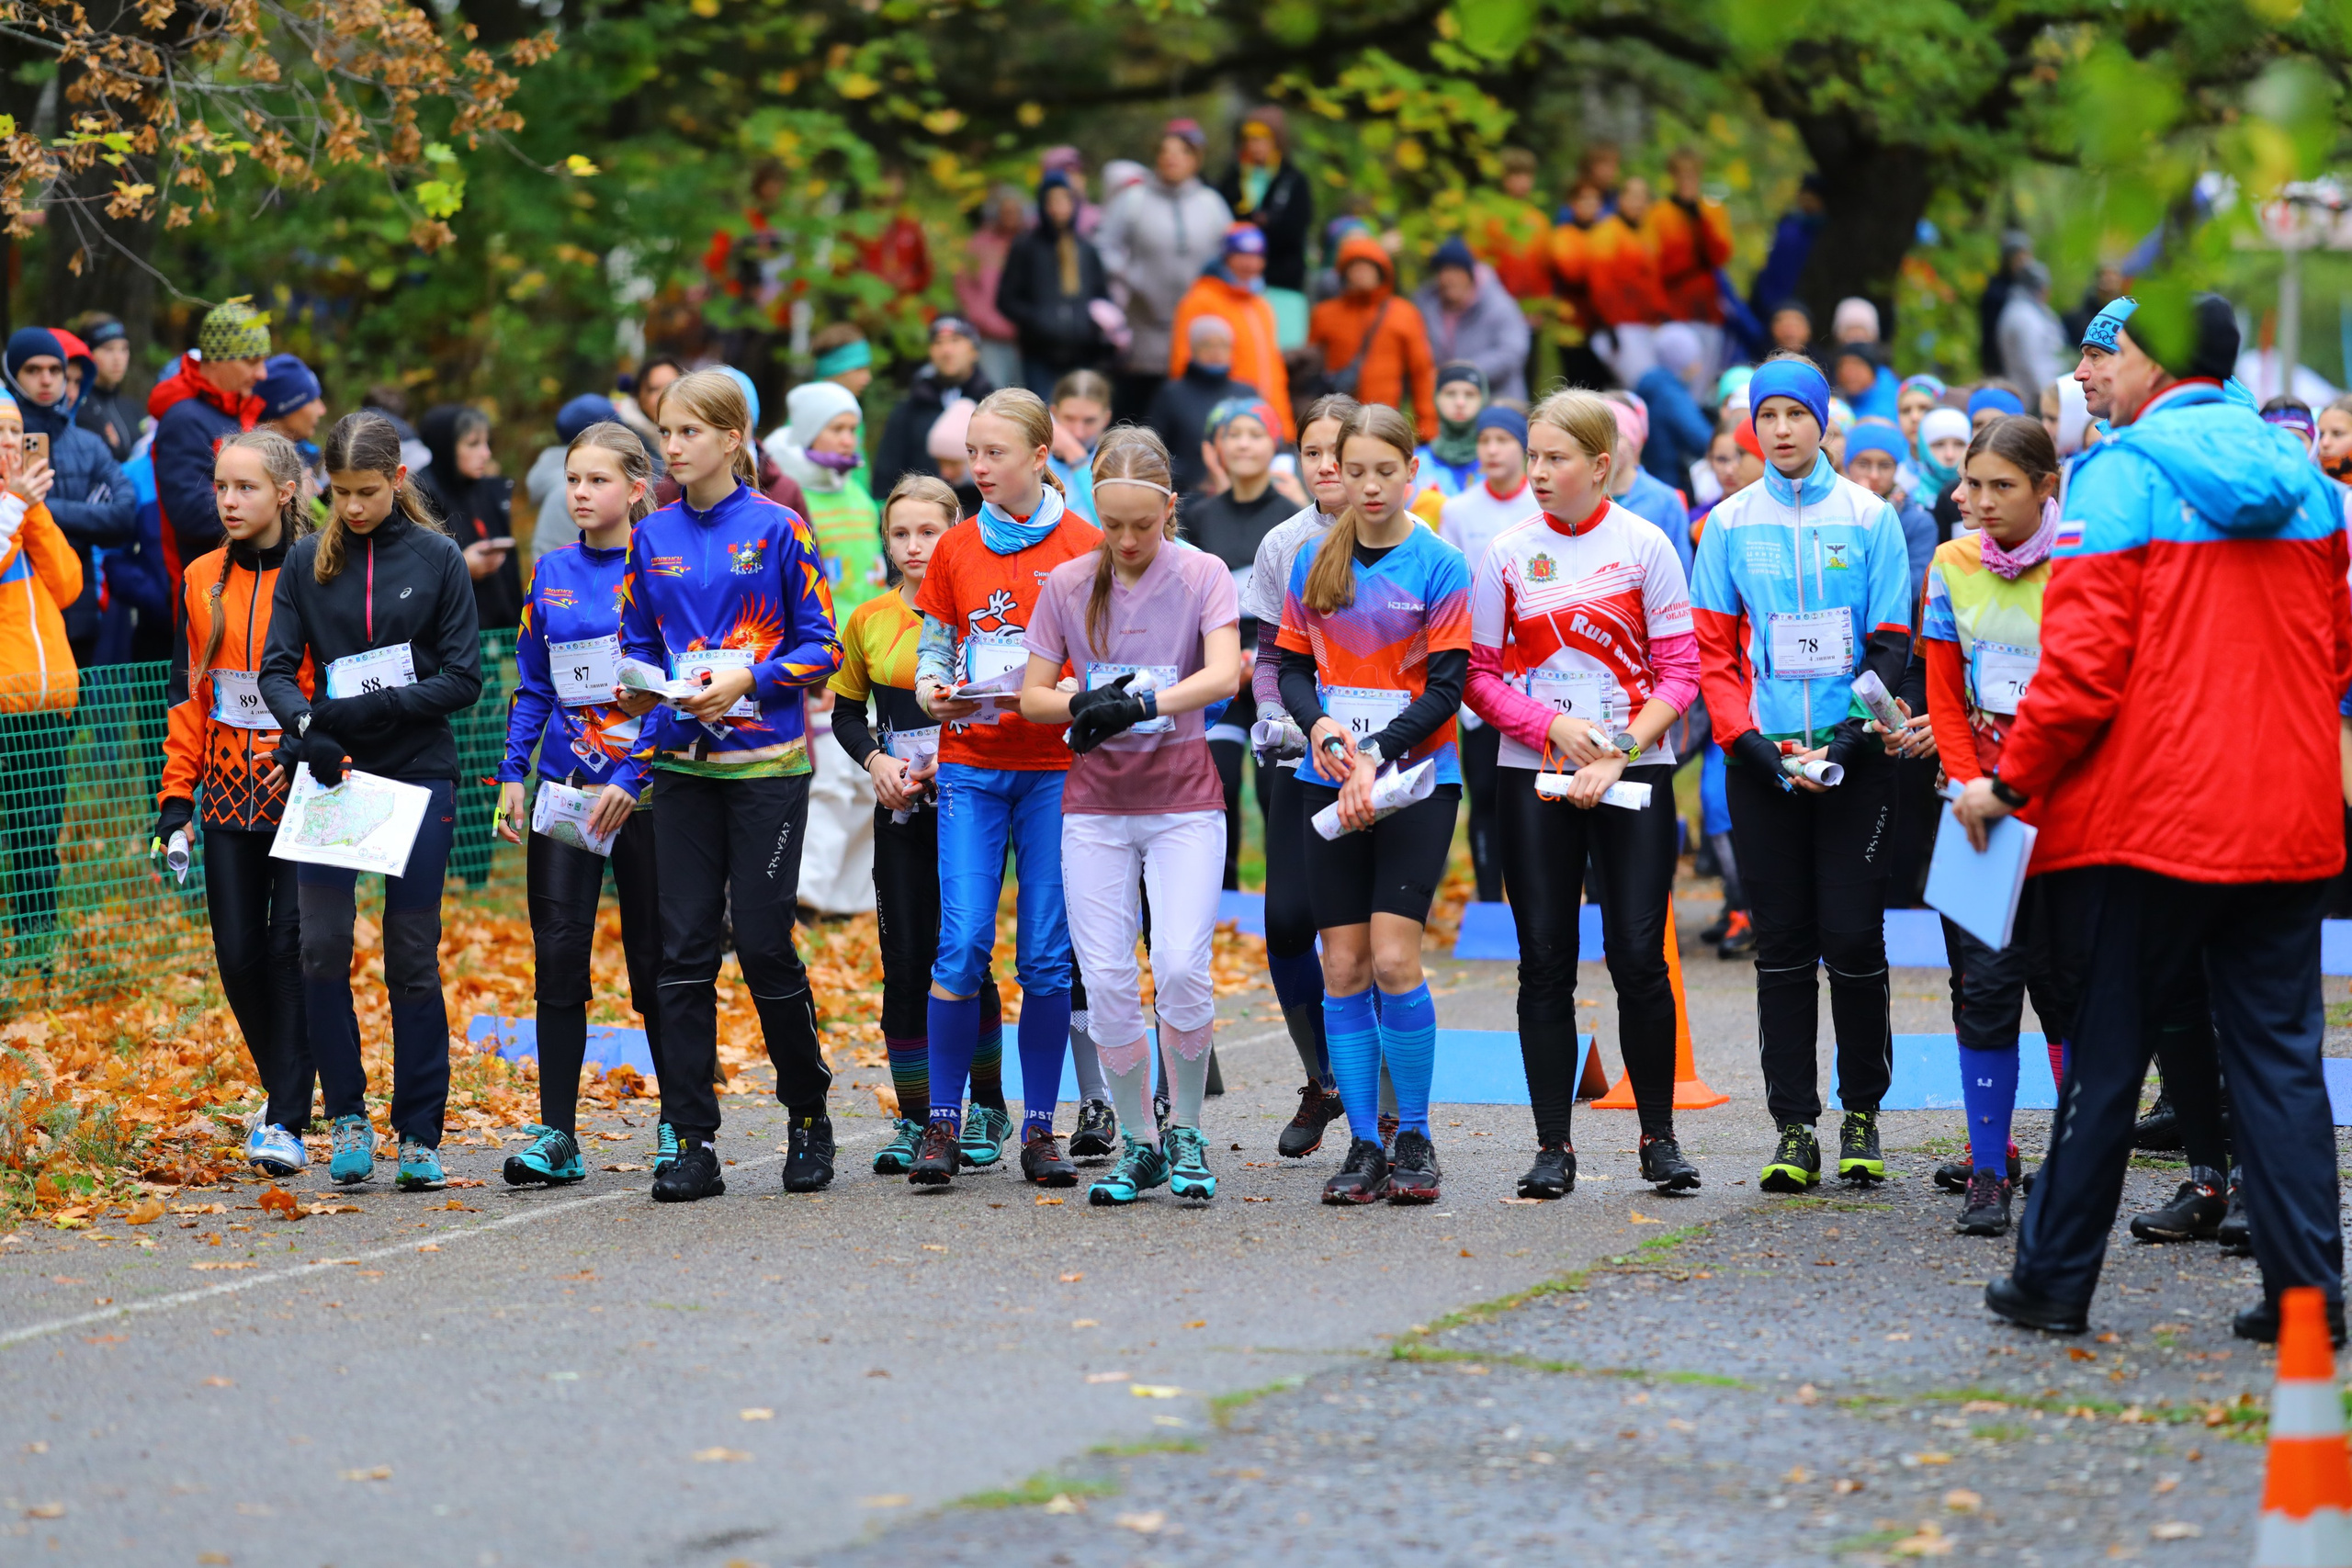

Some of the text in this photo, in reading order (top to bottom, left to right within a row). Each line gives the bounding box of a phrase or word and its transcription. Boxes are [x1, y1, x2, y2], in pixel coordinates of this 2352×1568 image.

[1569, 613, 1612, 648] Run
[1613, 644, 1642, 677] and
[1798, 637, 1819, 654] 78
[573, 666, 590, 682] 87
[361, 676, 382, 694] 88
[2008, 680, 2028, 696] 76
[239, 694, 258, 708] 89
[1554, 698, 1572, 714] 79
[1351, 716, 1370, 733] 81
[1864, 806, 1889, 863] ARSIVEAR
[766, 821, 791, 879] ARSIVEAR
